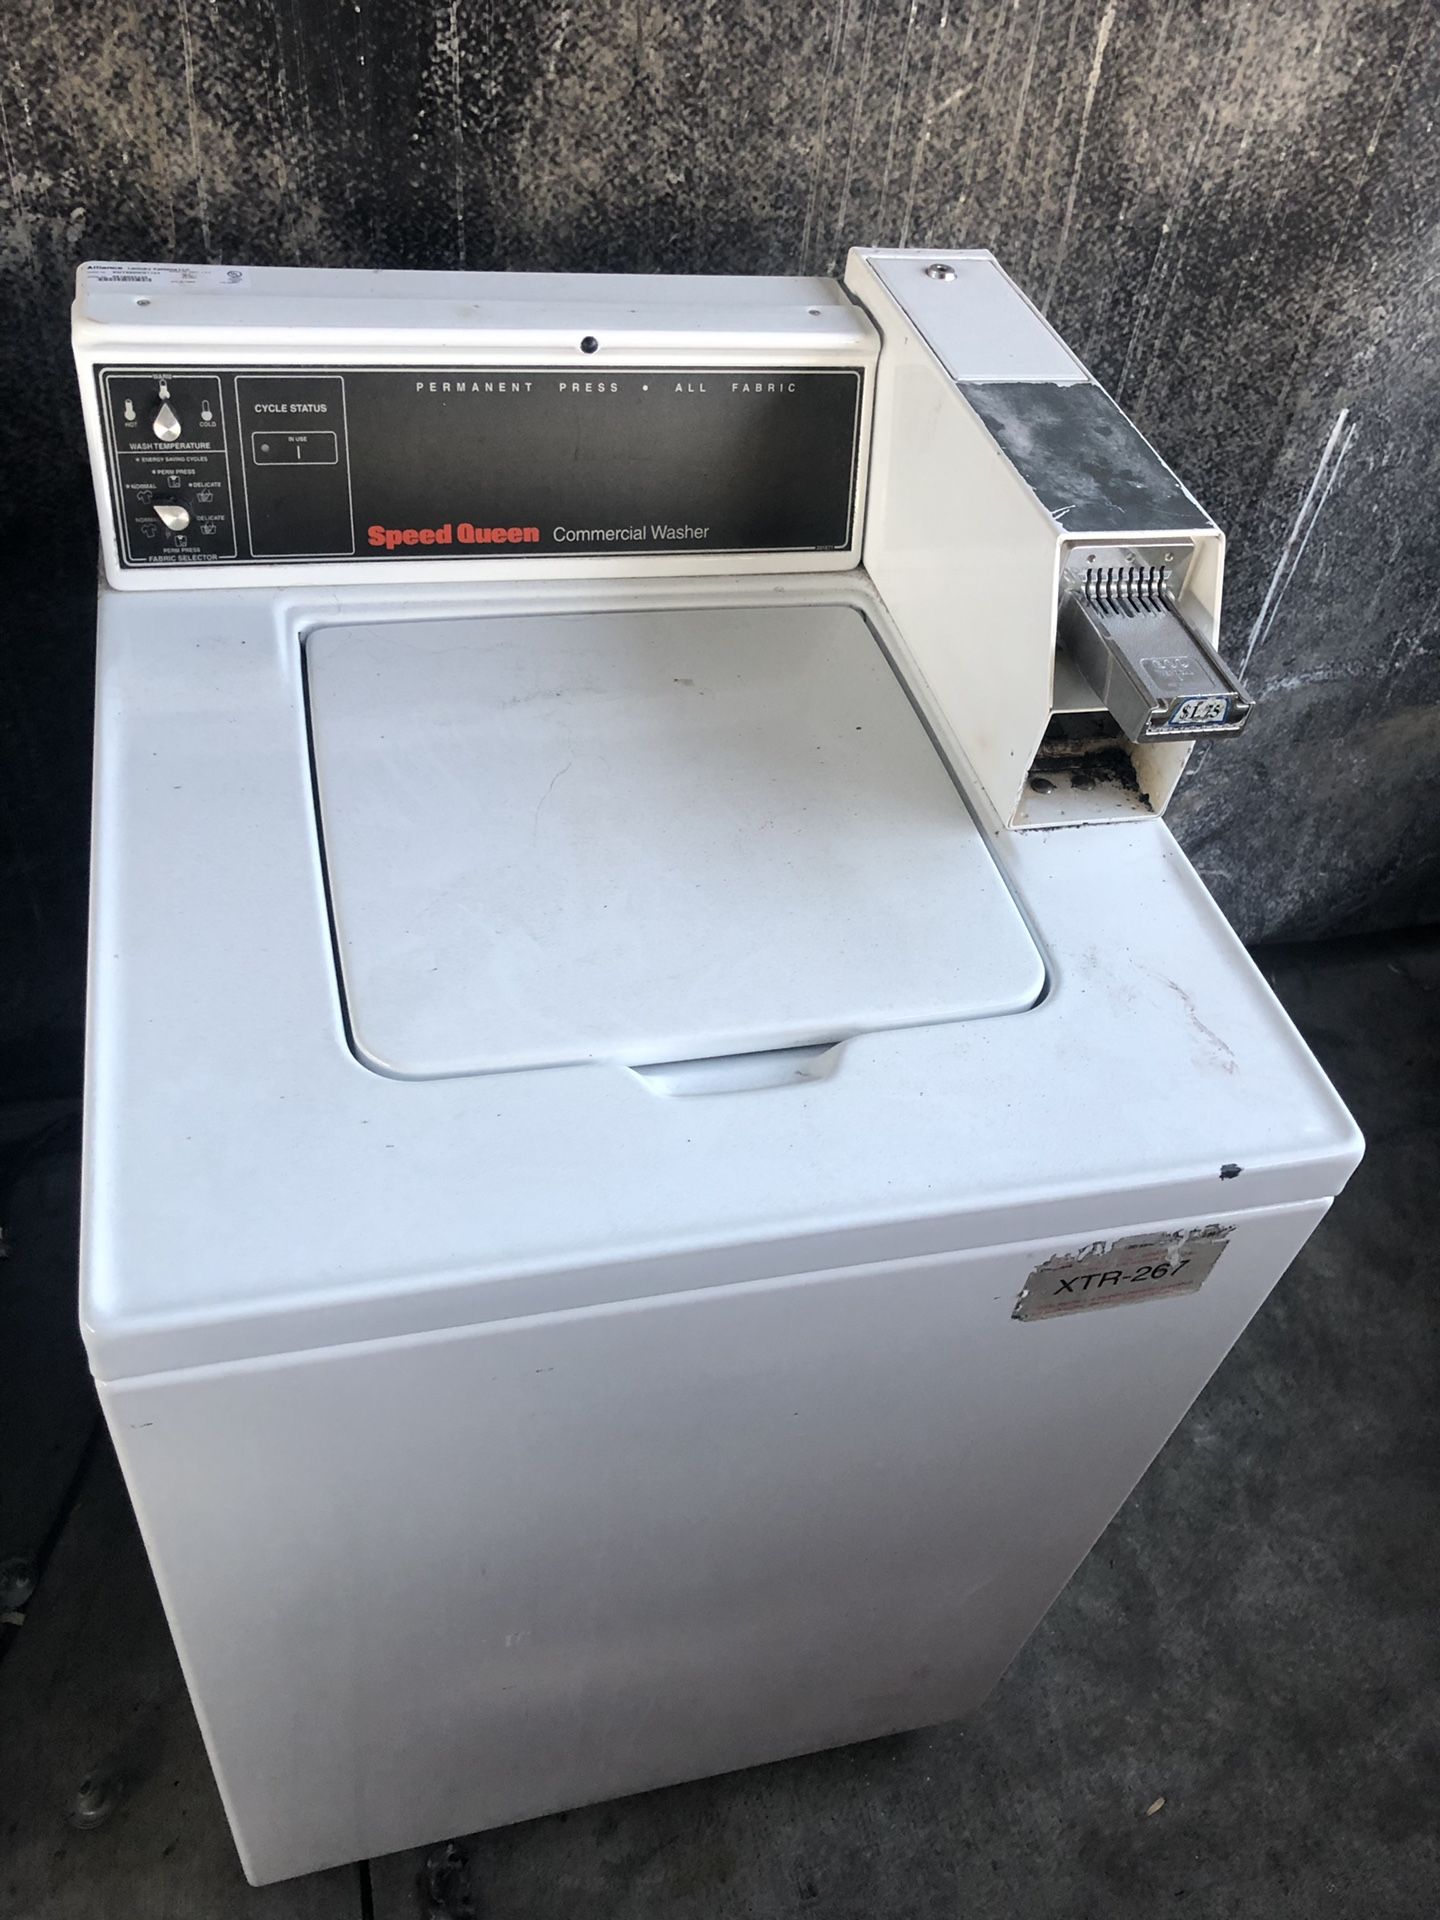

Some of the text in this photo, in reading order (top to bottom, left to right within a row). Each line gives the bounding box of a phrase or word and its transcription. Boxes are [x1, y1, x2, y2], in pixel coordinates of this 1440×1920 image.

[416, 382, 796, 393] PERMANENT PRESS ALL FABRIC
[254, 404, 328, 413] CYCLE STATUS
[368, 523, 710, 550] Speed Queen Commercial Washer
[1053, 1260, 1190, 1295] XTR-267
